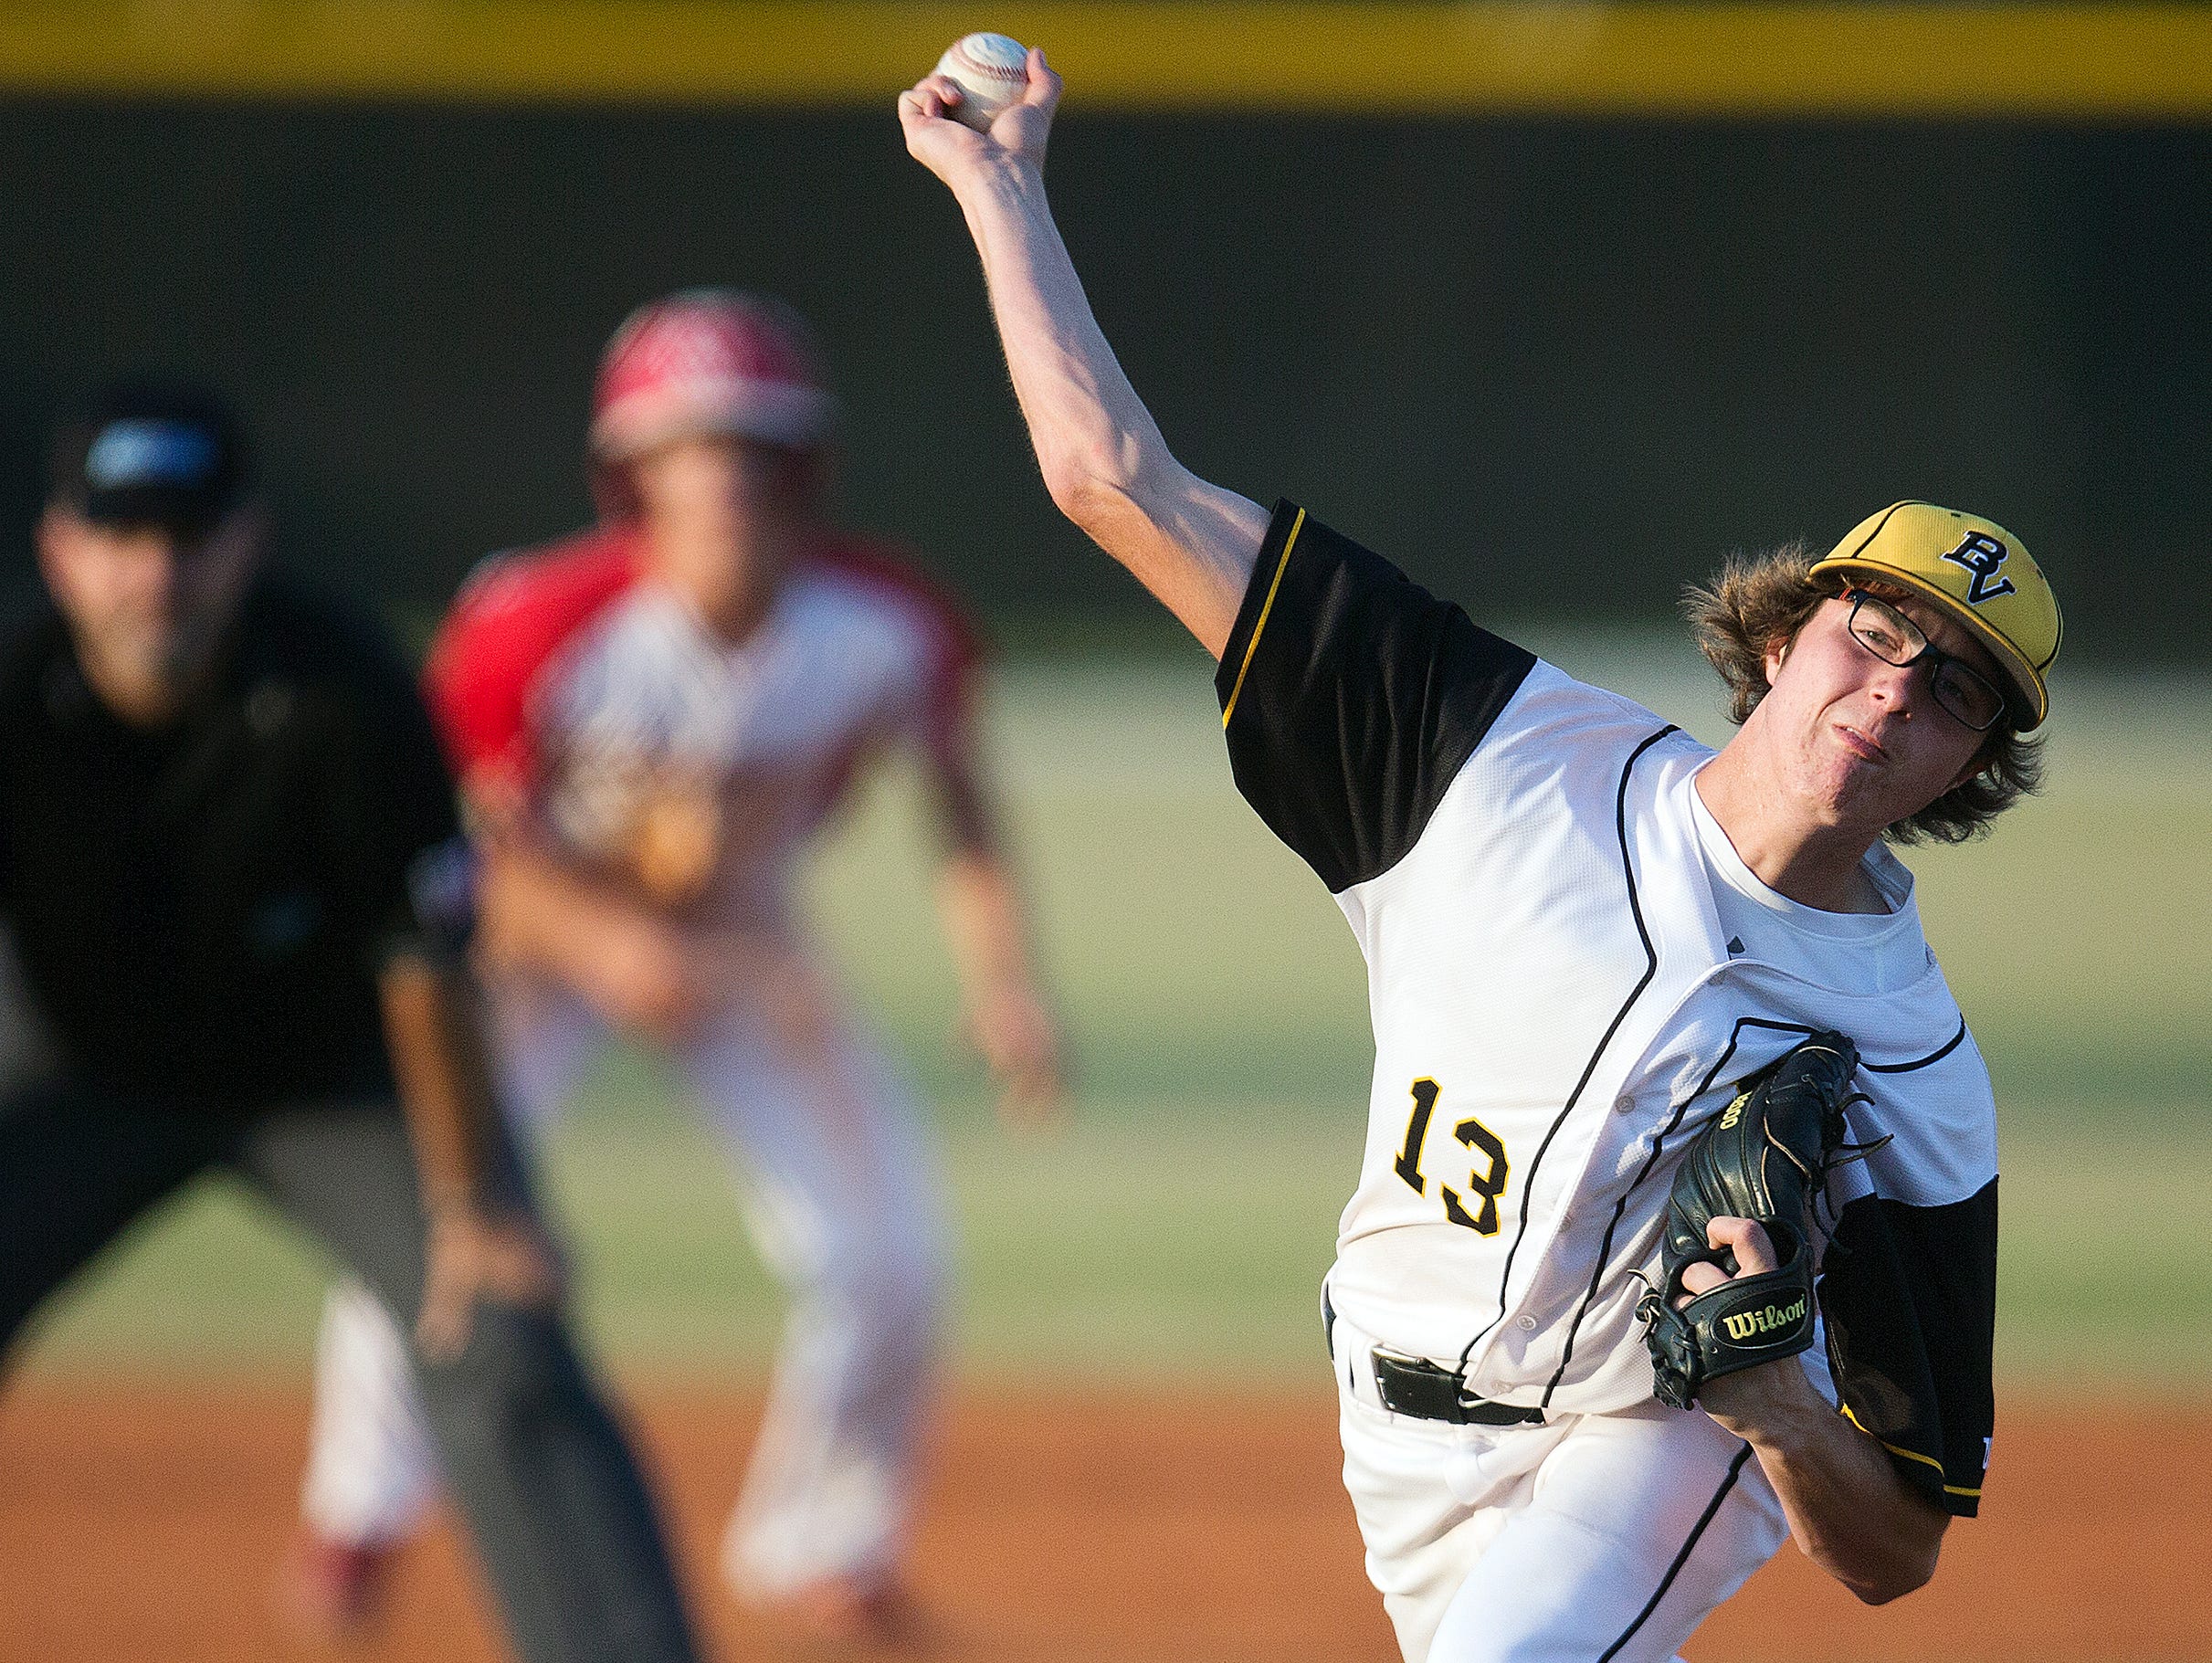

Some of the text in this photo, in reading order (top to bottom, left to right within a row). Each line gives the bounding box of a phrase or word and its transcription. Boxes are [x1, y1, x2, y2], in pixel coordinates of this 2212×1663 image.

[1939, 530, 2017, 605] BV
[1393, 1076, 1511, 1237] 13
[1722, 1298, 1806, 1340] Wilson
